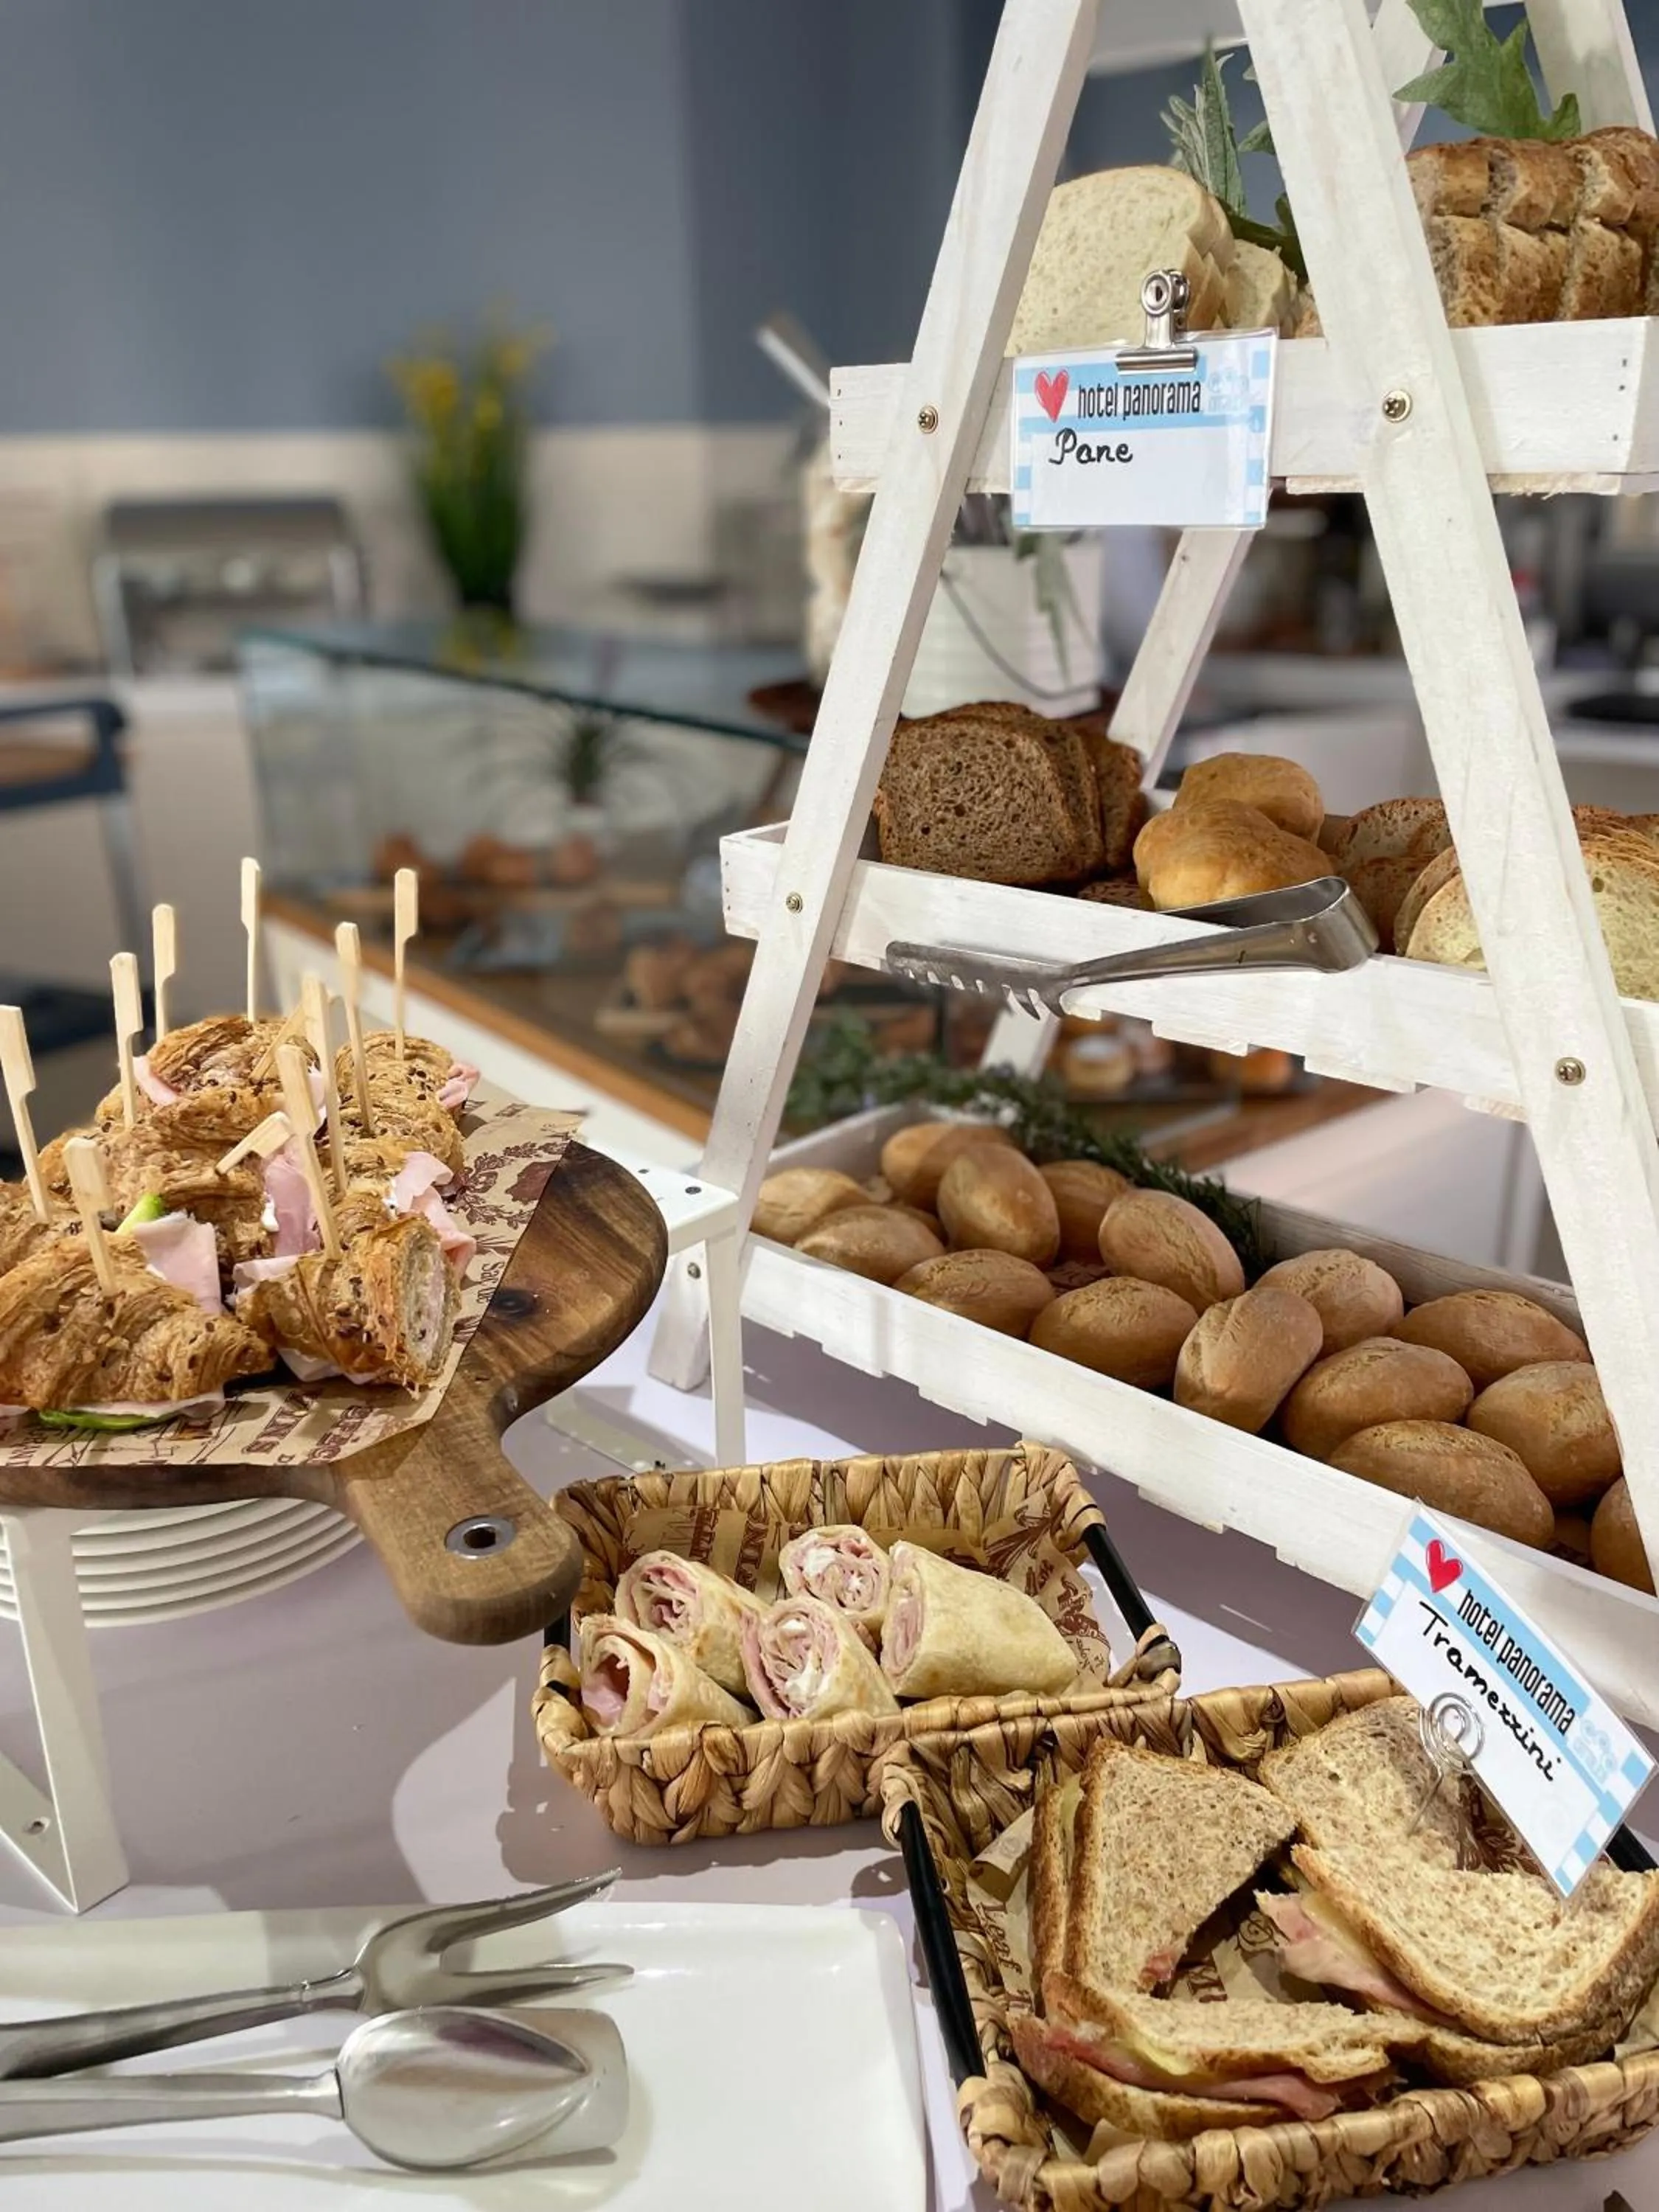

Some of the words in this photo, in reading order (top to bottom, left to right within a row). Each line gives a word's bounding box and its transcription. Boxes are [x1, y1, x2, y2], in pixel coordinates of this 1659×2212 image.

[1048, 428, 1133, 465] Pane
[1078, 383, 1118, 418] hotel
[1123, 381, 1201, 420] panorama
[1419, 1601, 1561, 1781] Tramezzini
[1456, 1589, 1504, 1650] hotel
[1497, 1636, 1576, 1735] panorama
